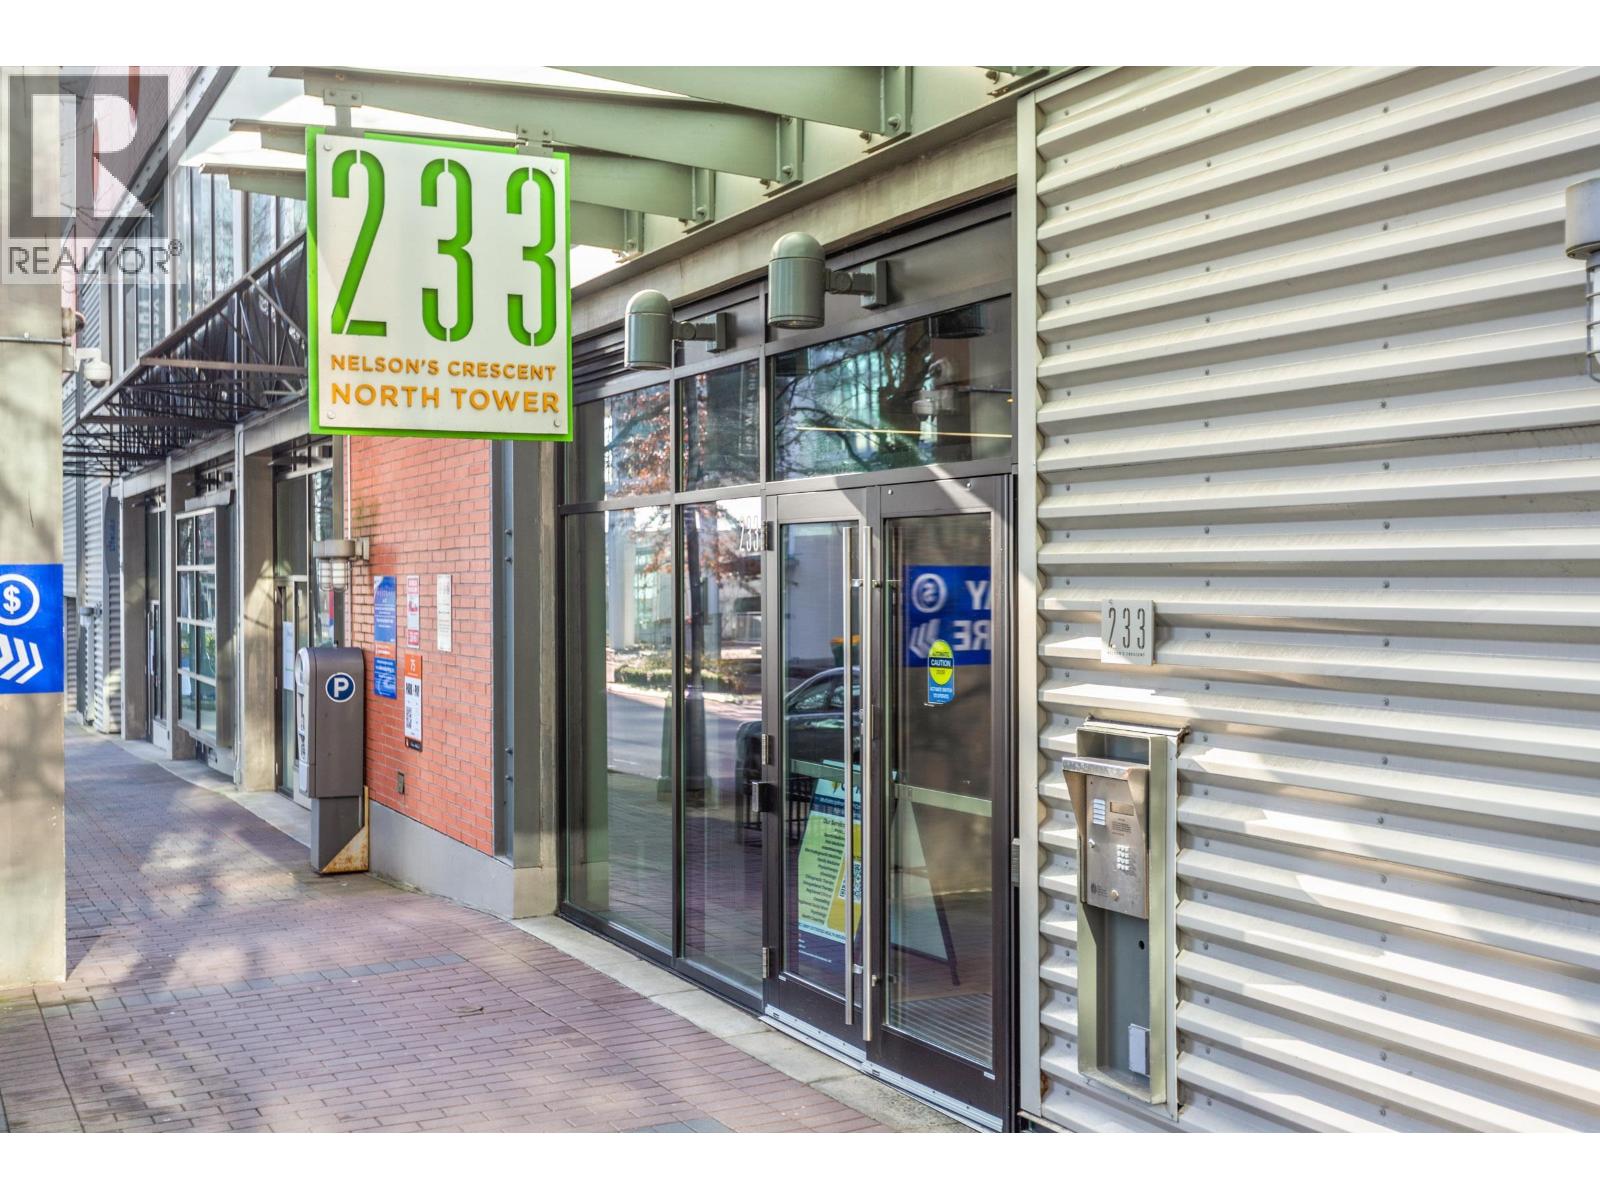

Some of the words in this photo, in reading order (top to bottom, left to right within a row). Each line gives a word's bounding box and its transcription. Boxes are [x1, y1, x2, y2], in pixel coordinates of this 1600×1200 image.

[331, 149, 558, 346] 233
[330, 354, 440, 376] NELSON'S
[447, 360, 557, 382] CRESCENT
[330, 383, 440, 408] NORTH
[450, 387, 560, 413] TOWER
[739, 515, 759, 552] 233
[1108, 607, 1145, 650] 233
[930, 659, 951, 667] CAUTION
[333, 677, 350, 698] P
